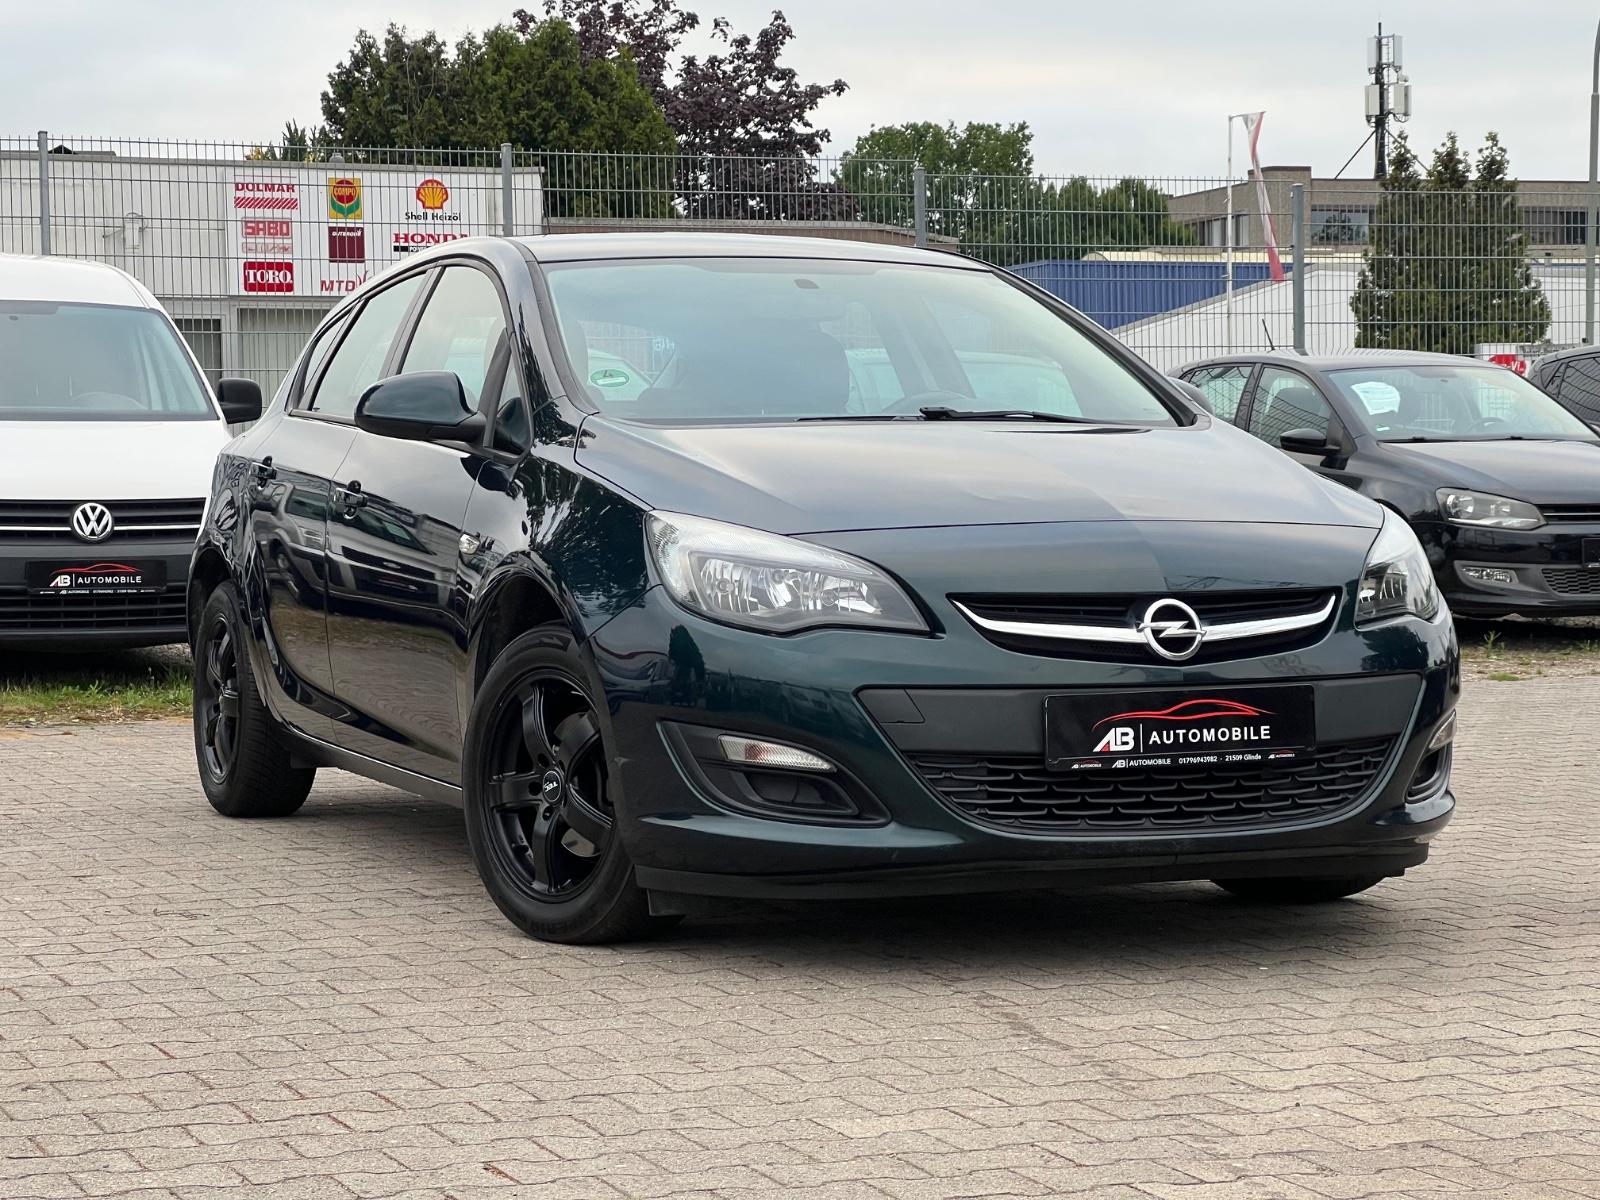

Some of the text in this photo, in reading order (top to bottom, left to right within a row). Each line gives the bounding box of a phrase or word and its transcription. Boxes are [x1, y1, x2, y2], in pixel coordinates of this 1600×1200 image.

[235, 183, 295, 192] DOLMAR
[333, 187, 356, 196] COMPO
[405, 211, 461, 221] Shell Heizöl
[244, 220, 290, 236] SABO
[245, 269, 292, 284] TORO
[320, 279, 356, 292] MTD
[49, 575, 142, 587] AB AUTOMOBILE
[1092, 725, 1271, 753] AB AUTOMOBILE
[1112, 759, 1126, 768] AB
[1129, 758, 1171, 767] AUTOMOBILE
[1178, 756, 1218, 764] 01796943982
